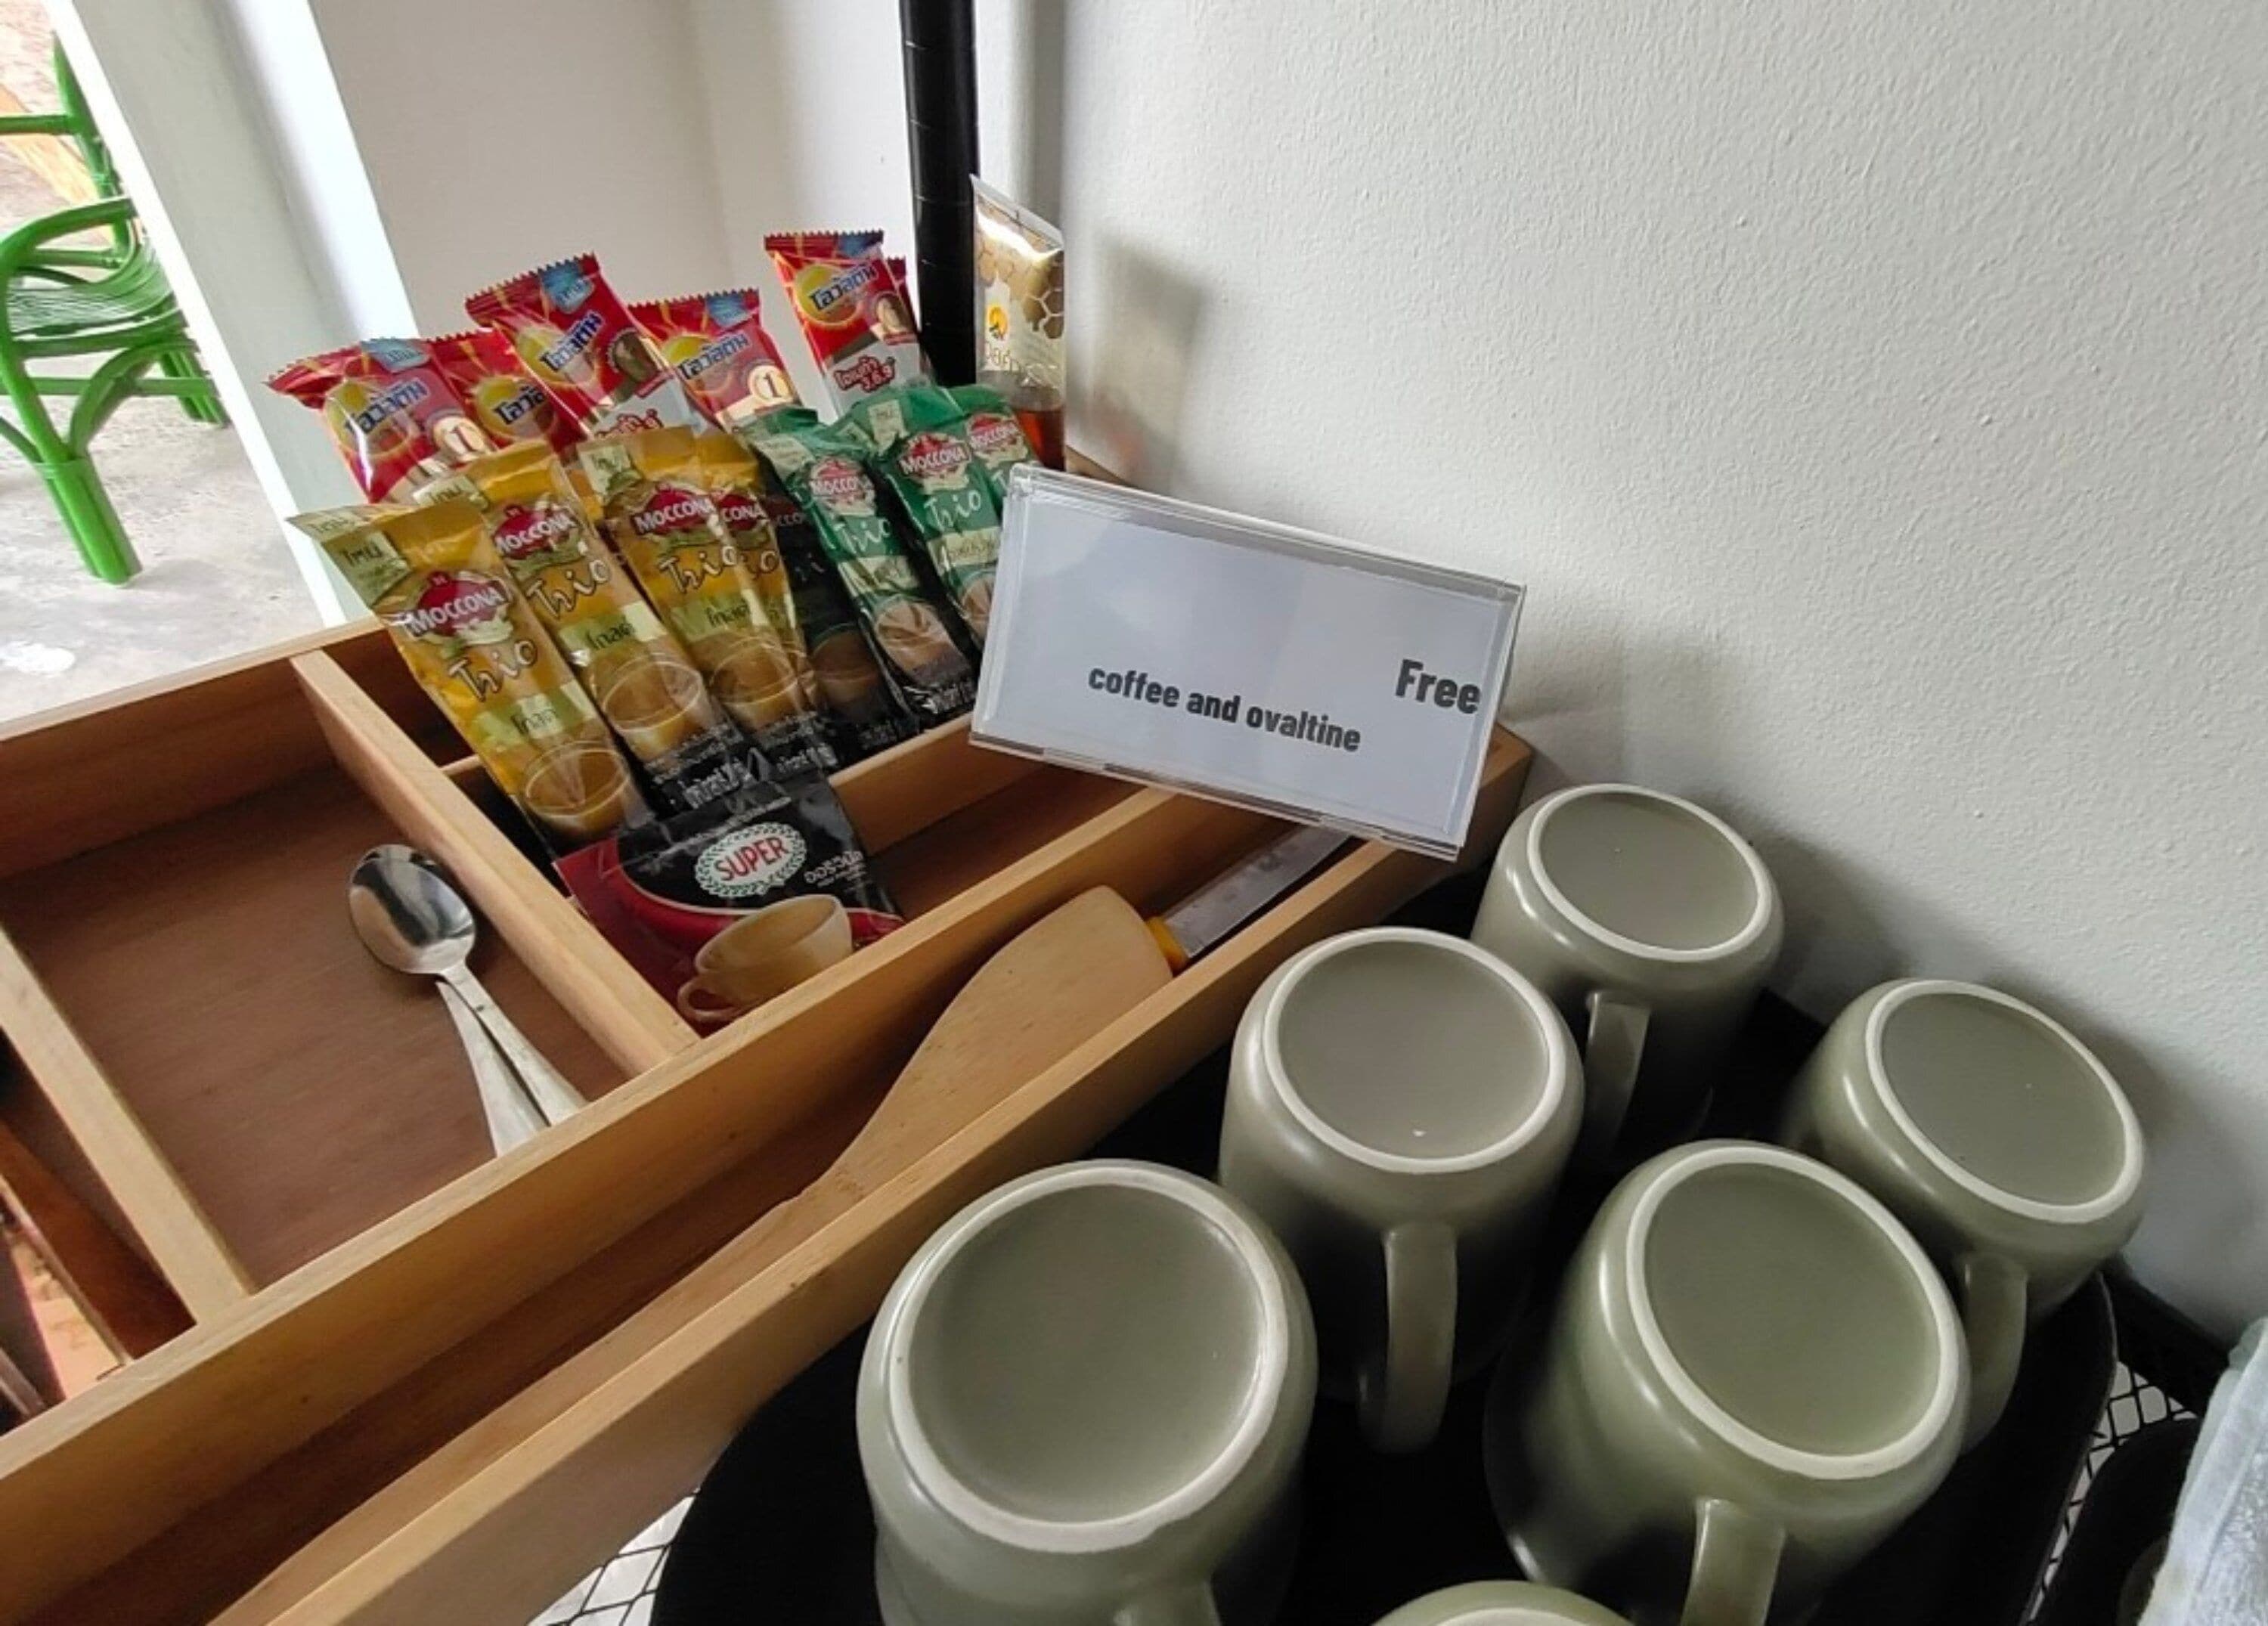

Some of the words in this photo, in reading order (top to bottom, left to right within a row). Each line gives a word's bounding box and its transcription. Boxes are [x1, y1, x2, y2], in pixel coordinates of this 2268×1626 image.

[899, 445, 968, 475] MOCCONA
[634, 497, 715, 534] MOCCONA
[526, 559, 609, 619] Trio
[658, 546, 739, 593] Trio
[408, 587, 506, 636] MOCCONA
[448, 640, 537, 702] Trio
[1396, 658, 1480, 714] Free
[1089, 667, 1179, 708] coffee
[1187, 692, 1241, 723] and
[1247, 706, 1362, 752] ovaltine
[714, 836, 791, 881] SUPER
